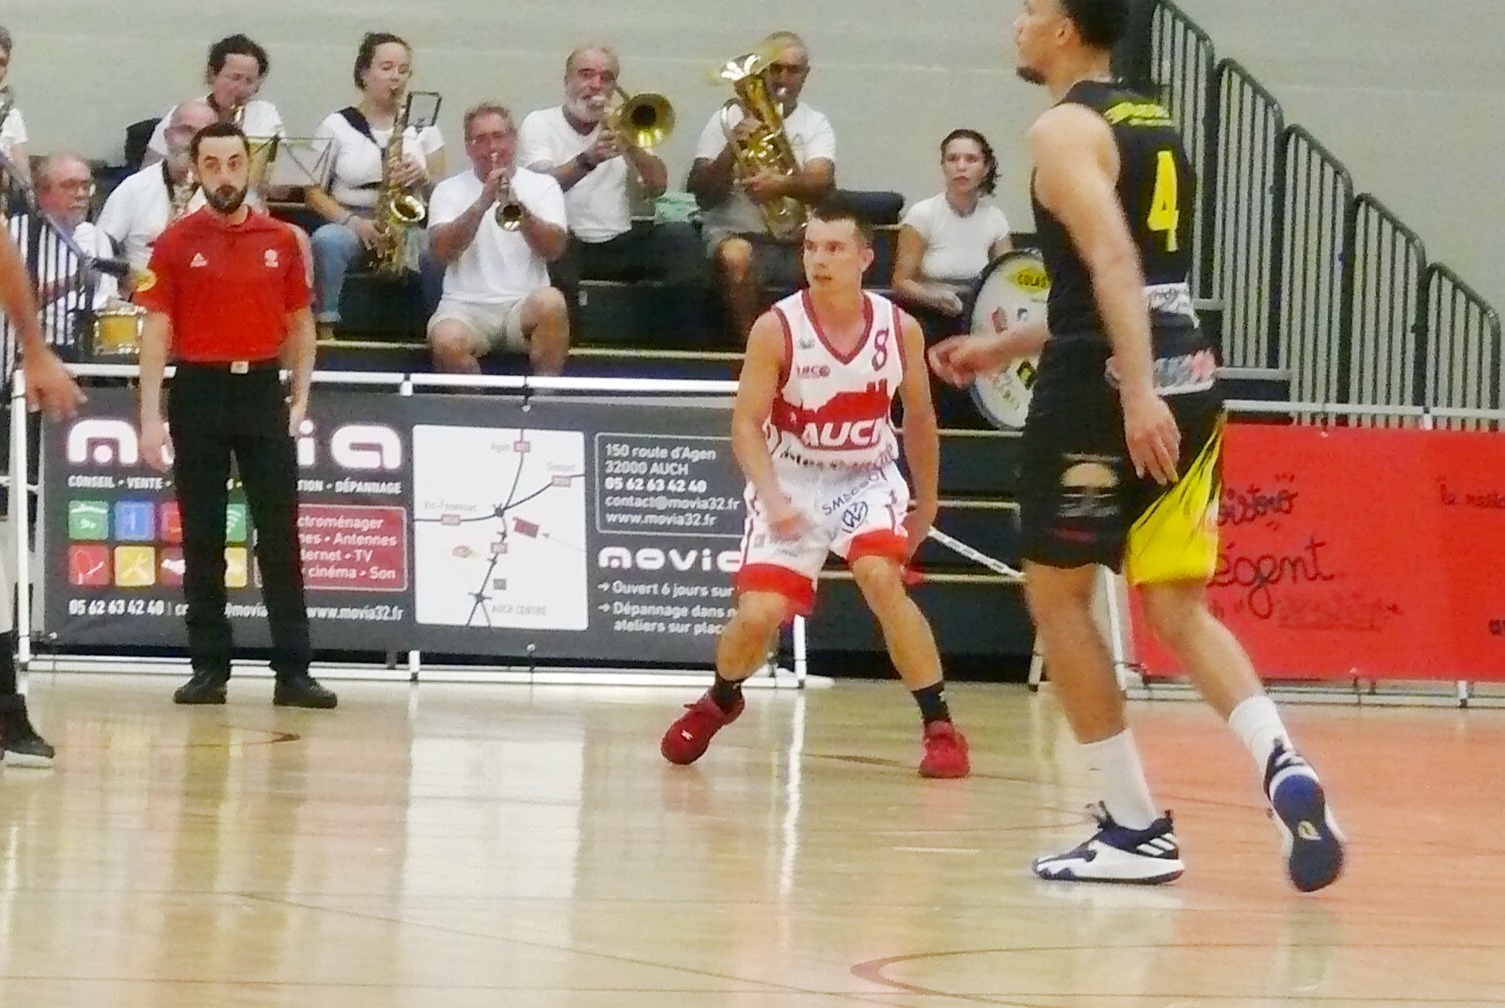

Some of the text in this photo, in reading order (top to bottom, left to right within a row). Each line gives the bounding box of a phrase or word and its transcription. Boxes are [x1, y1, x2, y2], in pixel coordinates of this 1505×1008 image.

[1147, 150, 1179, 252] 4
[871, 328, 890, 372] 8
[66, 417, 403, 472] mia
[605, 443, 716, 462] 150 route d'Agen
[605, 461, 689, 476] 32000 AUCH
[68, 476, 163, 491] CONSEIL VENTE
[605, 477, 707, 493] 05 62 63 42 40
[605, 494, 740, 511] contact@movia32.fr
[297, 514, 384, 533] ctroménager
[605, 512, 717, 527] www.movia32.fr
[335, 532, 397, 547] Antennes
[300, 548, 373, 562] ternet TV
[308, 565, 396, 580] cinéma Son
[1207, 537, 1336, 620] égent
[612, 580, 734, 598] Ouvert 6 jours sur
[69, 600, 87, 614] 05
[88, 600, 106, 615] 62
[108, 601, 125, 615] 63
[127, 601, 145, 615] 42
[147, 601, 164, 616] 40
[613, 601, 688, 619] Dépannage
[691, 604, 725, 618] dans
[614, 619, 724, 637] ateliers sur plac
